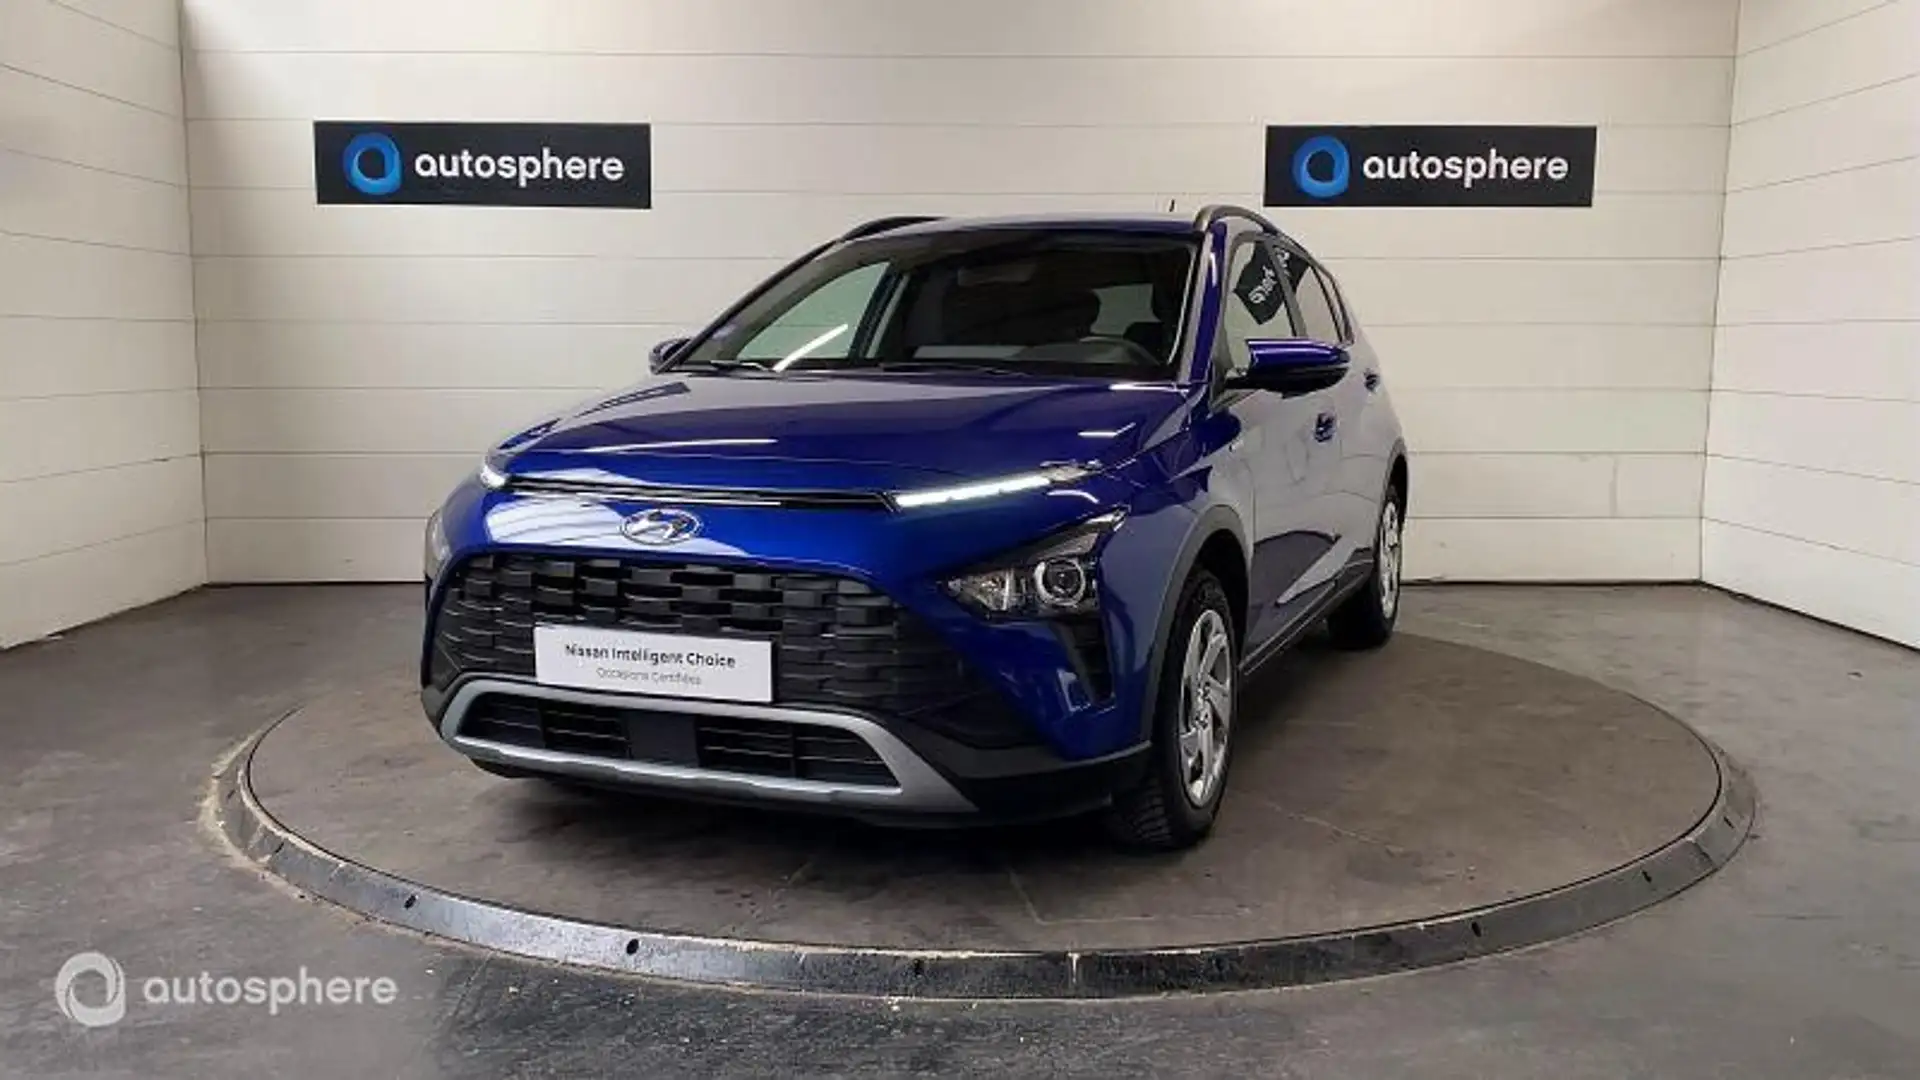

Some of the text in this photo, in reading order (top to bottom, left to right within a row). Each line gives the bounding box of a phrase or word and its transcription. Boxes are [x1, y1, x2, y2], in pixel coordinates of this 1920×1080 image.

[415, 147, 625, 187] autosphere
[1363, 148, 1569, 188] autosphere
[565, 643, 736, 669] Nissan Intelligent Choice
